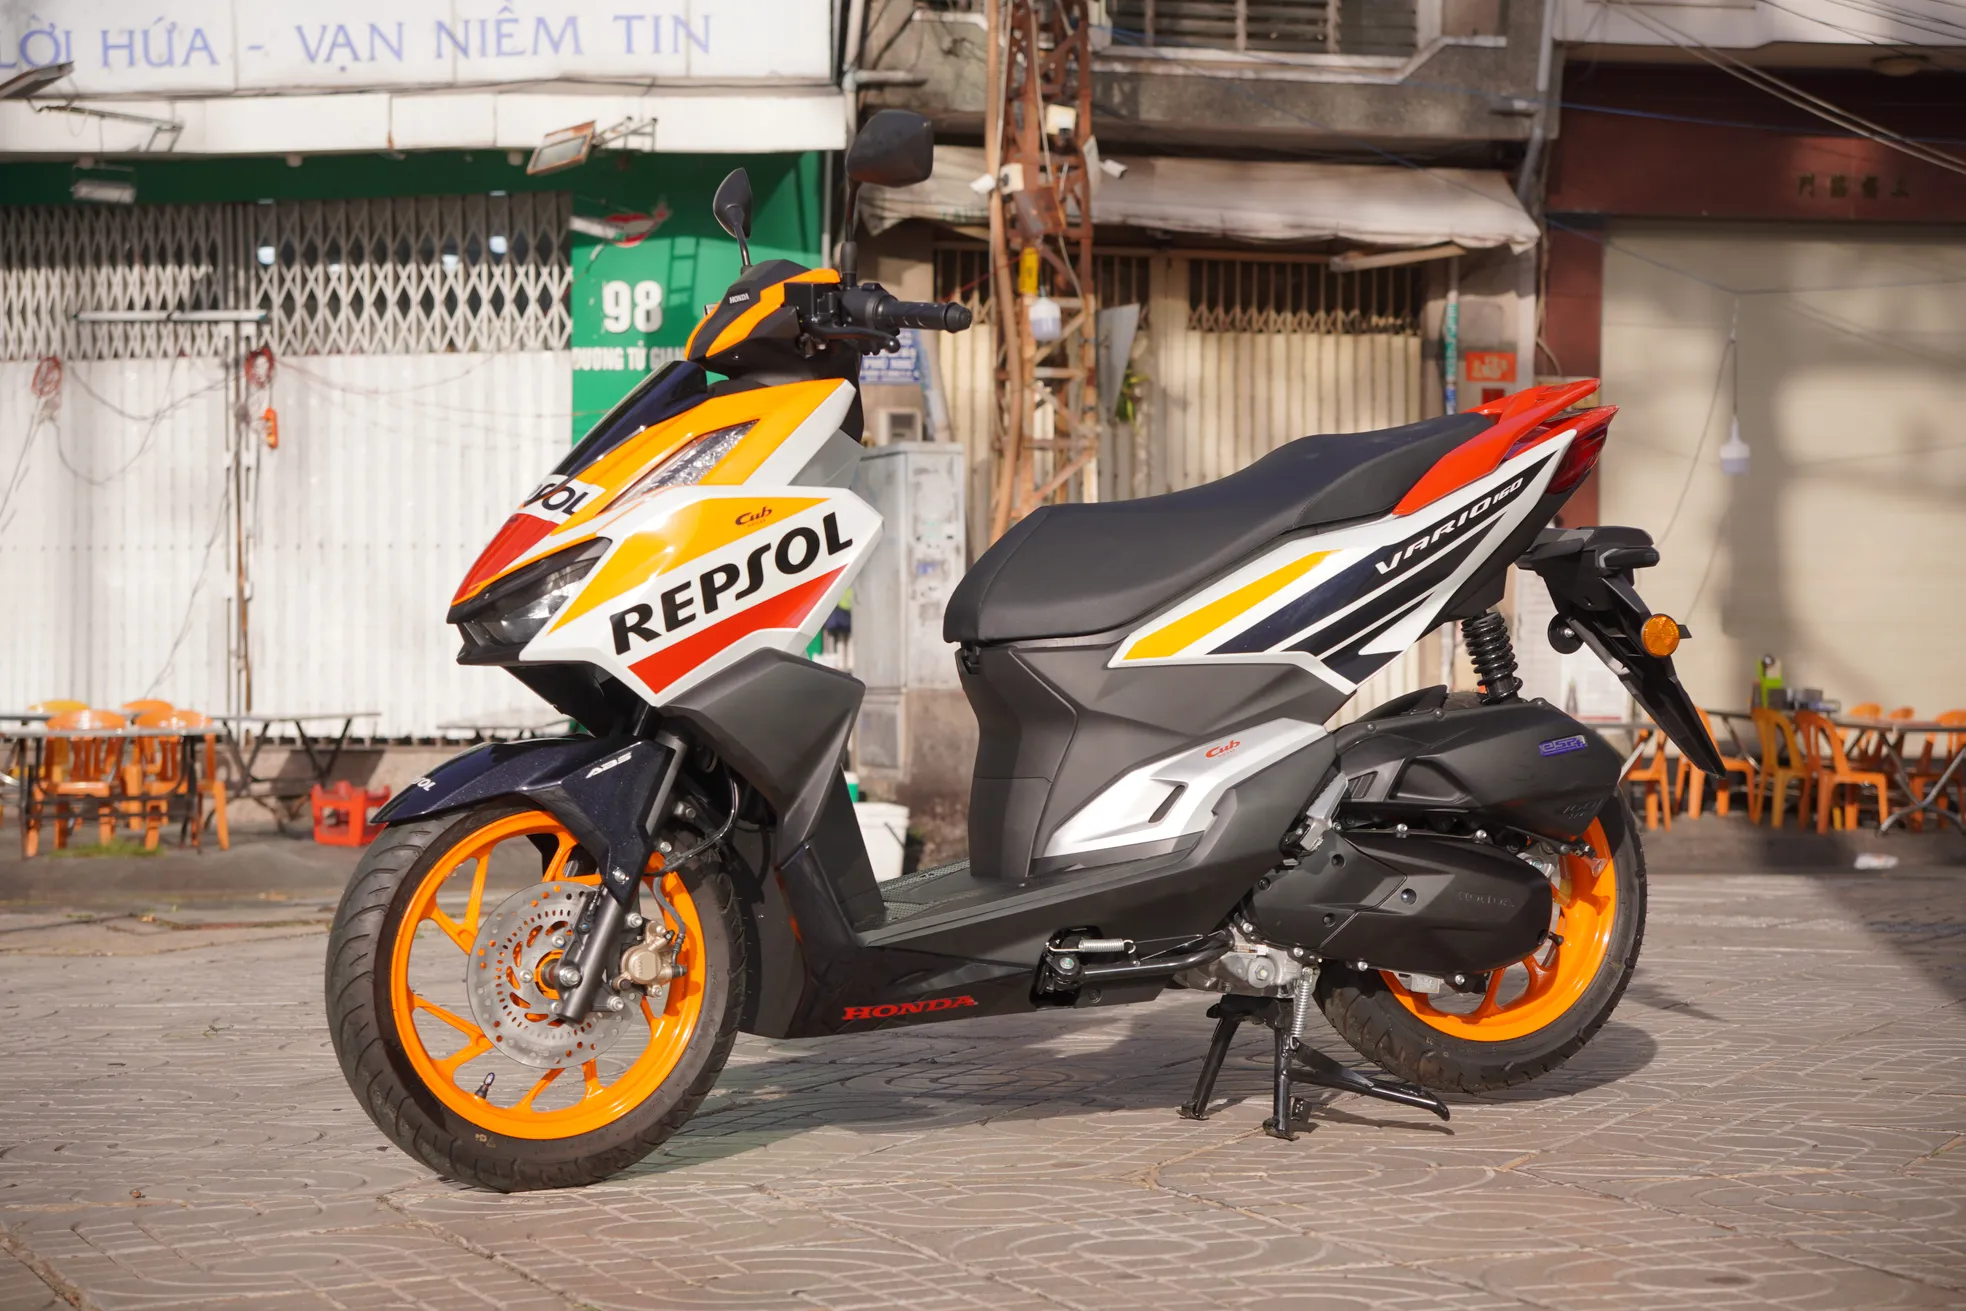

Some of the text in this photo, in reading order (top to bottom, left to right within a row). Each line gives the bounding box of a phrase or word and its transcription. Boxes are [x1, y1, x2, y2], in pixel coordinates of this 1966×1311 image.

[99, 16, 220, 67] HỨA
[294, 21, 405, 73] VẠN
[612, 14, 711, 55] TIN
[603, 280, 663, 334] 98
[729, 292, 750, 304] HONDA
[735, 506, 773, 526] Cub
[1375, 477, 1524, 574] VARIO 160
[609, 511, 854, 656] REPSOL
[1205, 739, 1241, 759] Cub
[585, 750, 632, 779] ABS
[841, 995, 978, 1021] HONDA
